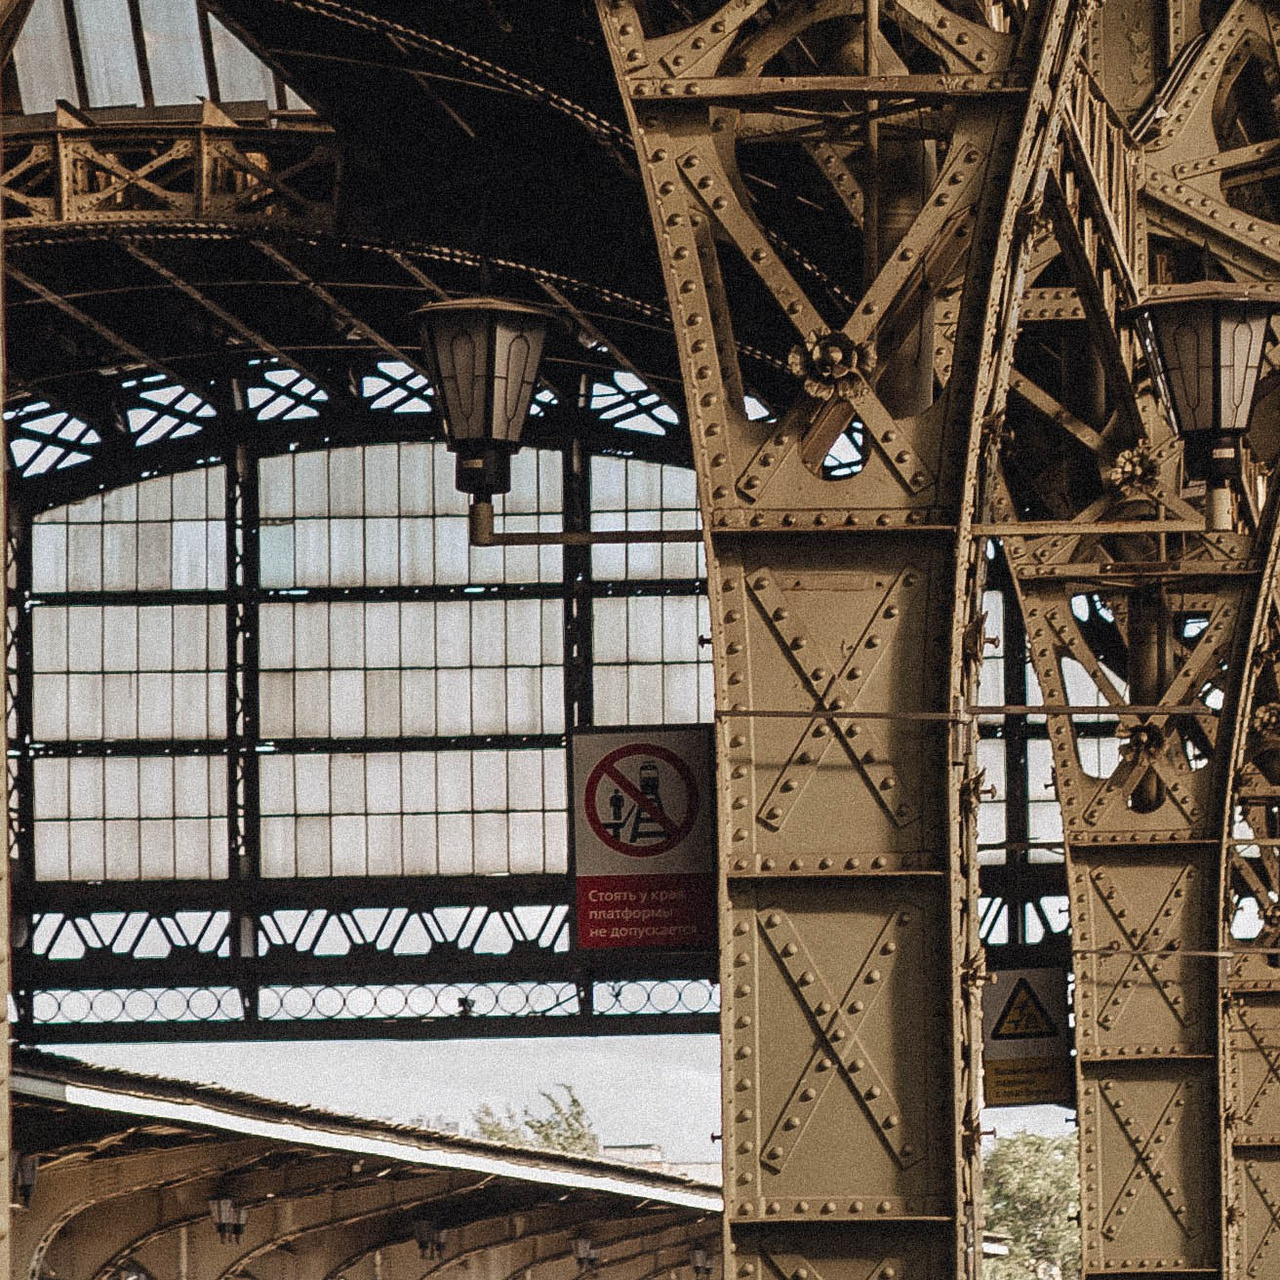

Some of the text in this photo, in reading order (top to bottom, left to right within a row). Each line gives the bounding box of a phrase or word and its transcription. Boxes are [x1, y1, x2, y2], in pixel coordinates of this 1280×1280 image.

[588, 889, 685, 903] Стоять у края
[588, 906, 674, 922] платформы
[589, 925, 698, 939] не допускается
